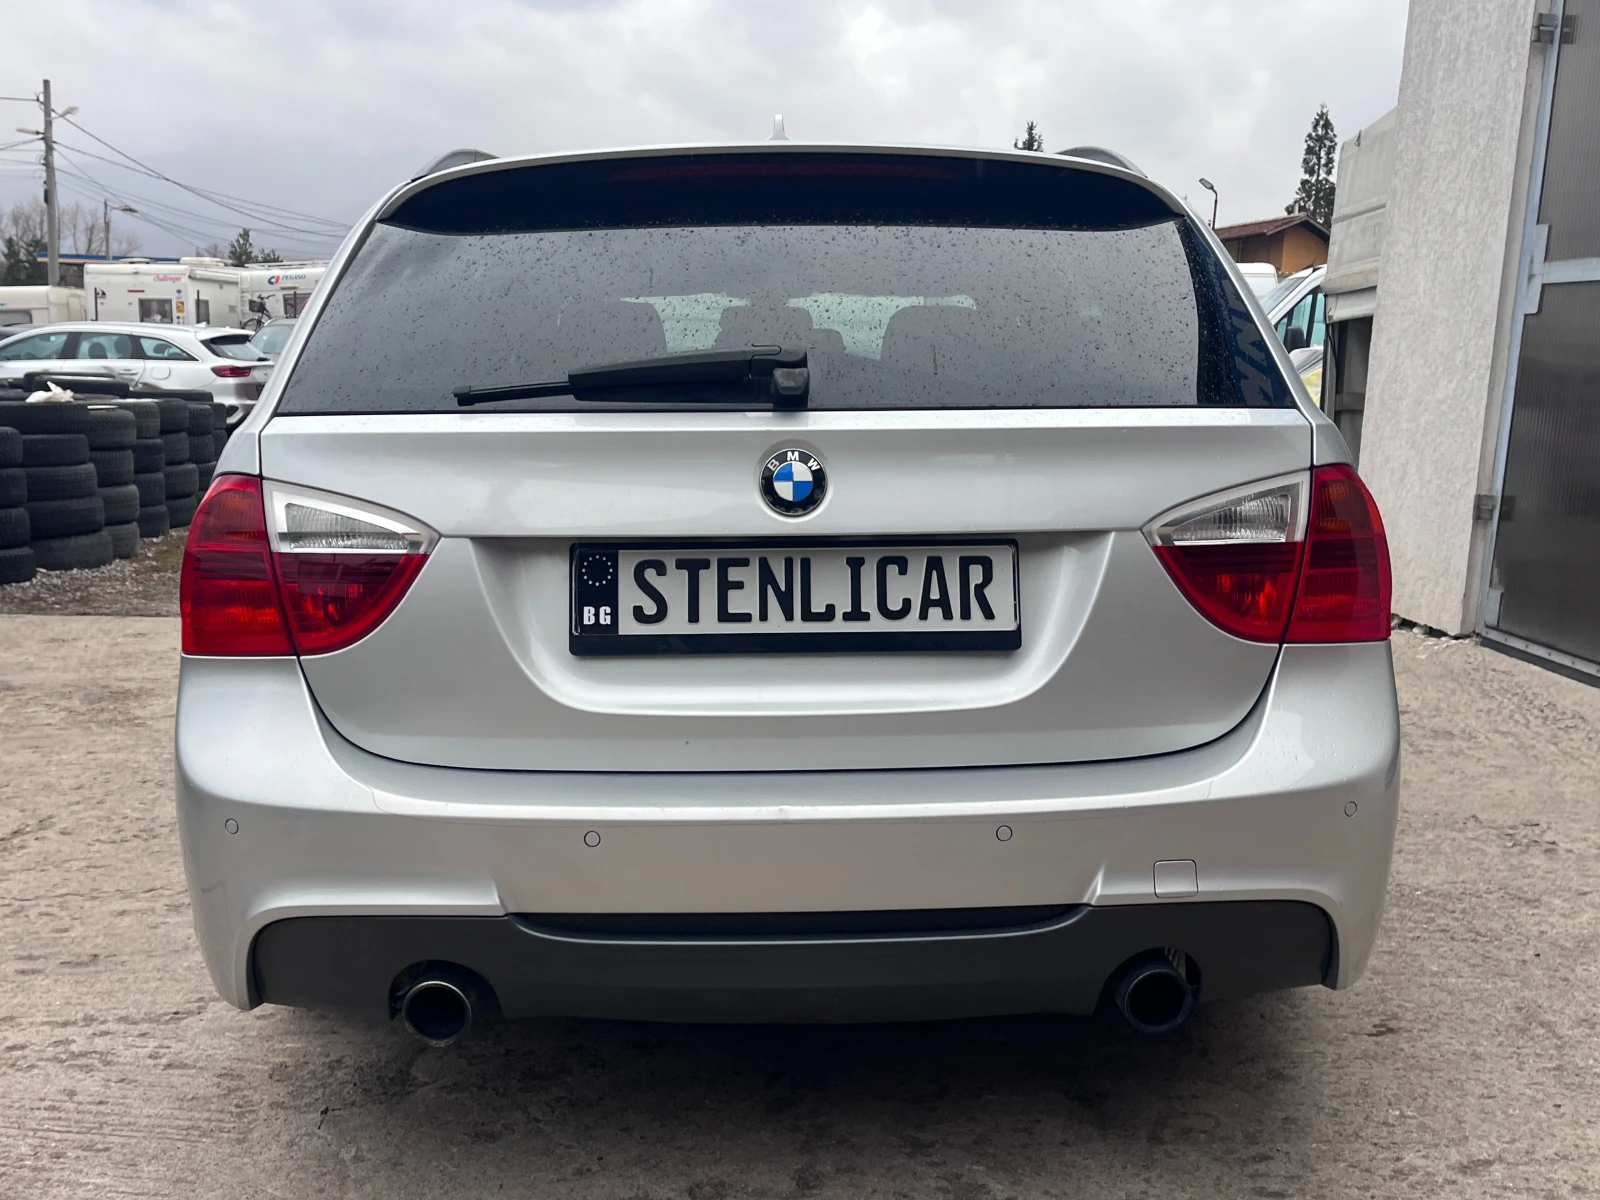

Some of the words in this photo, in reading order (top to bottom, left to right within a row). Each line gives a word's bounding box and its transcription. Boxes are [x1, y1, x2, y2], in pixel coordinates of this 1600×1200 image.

[767, 451, 820, 471] BMW
[632, 555, 996, 624] STENLICAR
[583, 606, 611, 625] BG
